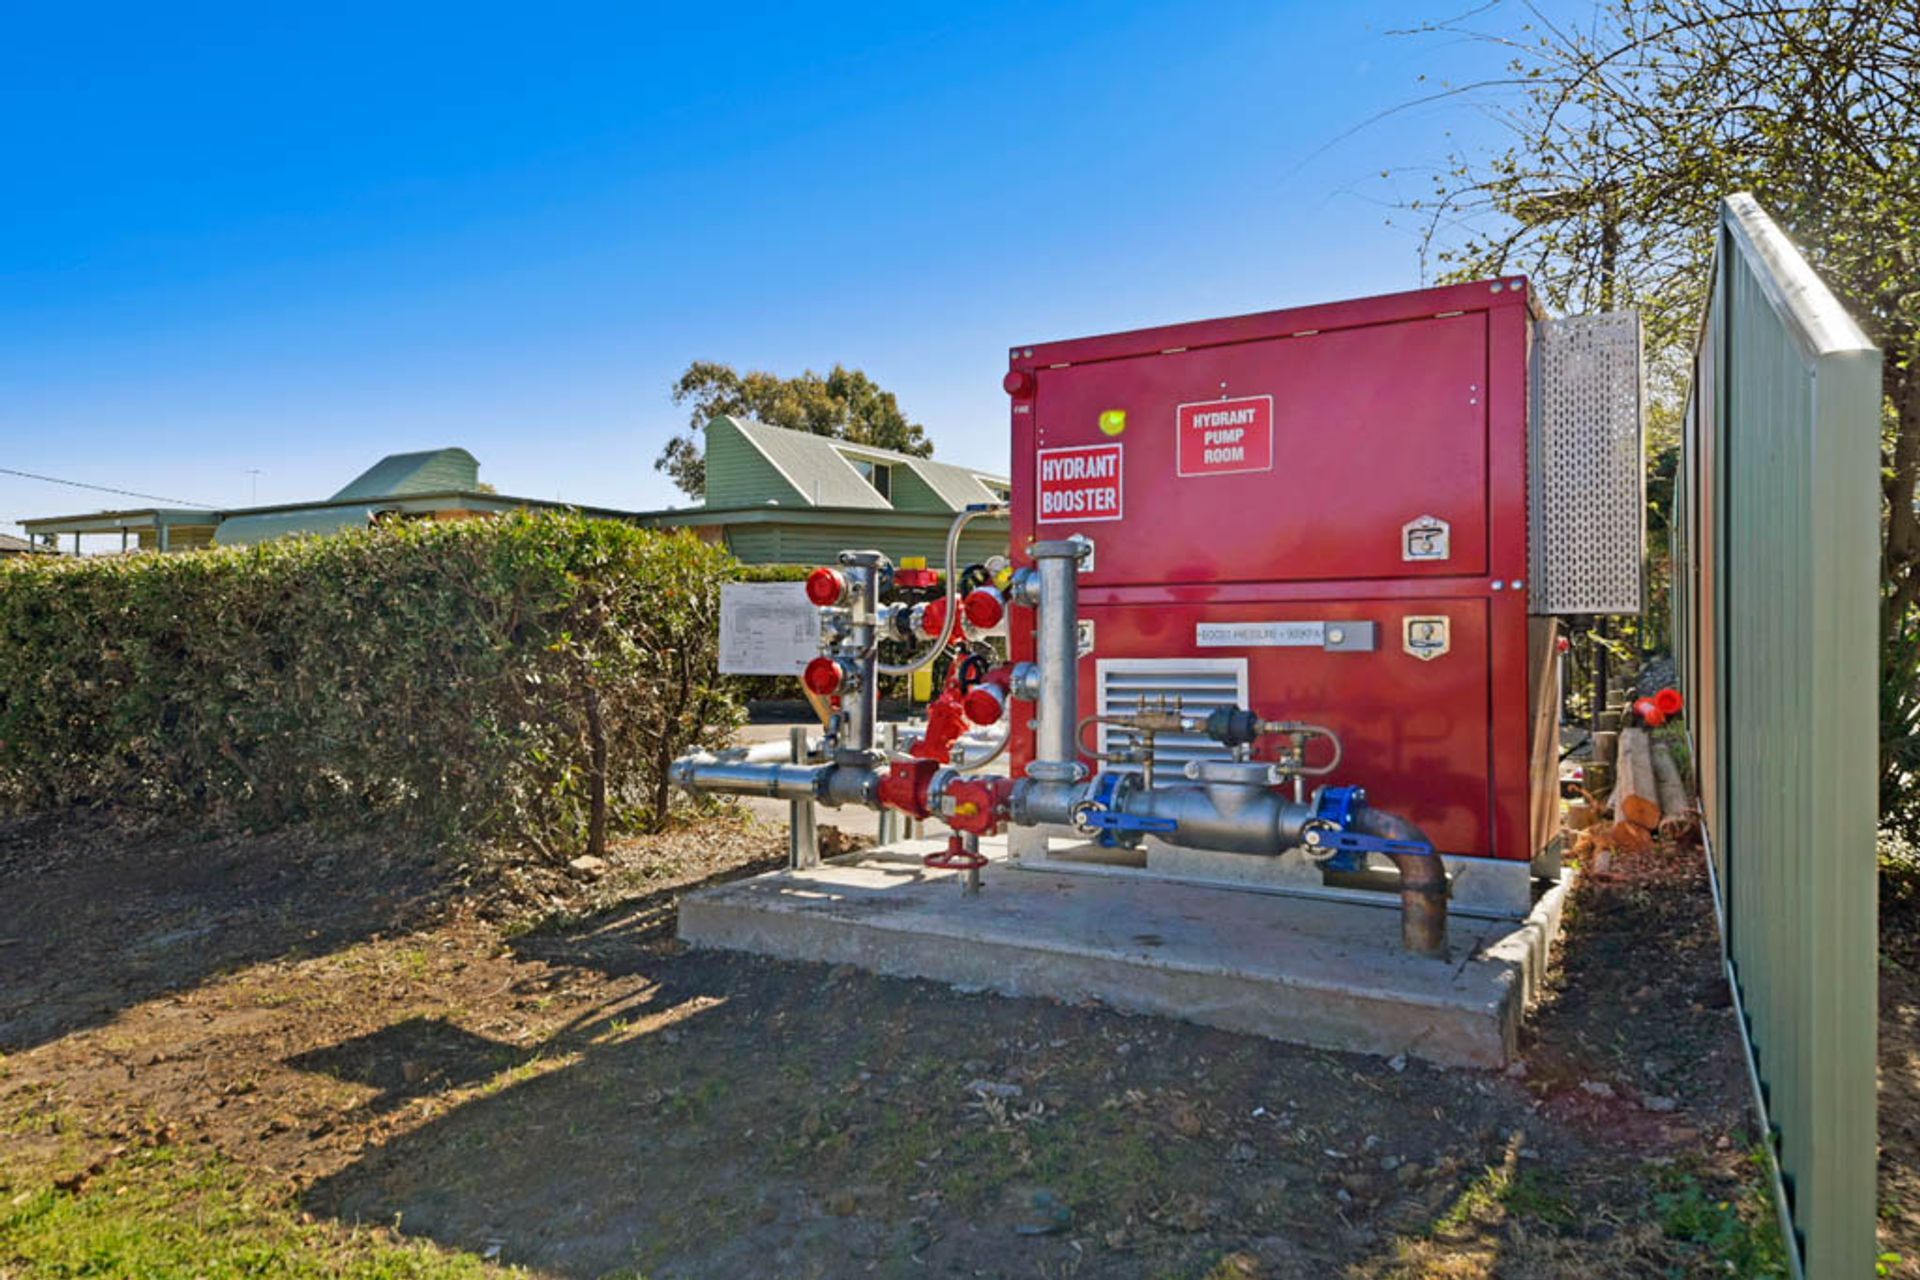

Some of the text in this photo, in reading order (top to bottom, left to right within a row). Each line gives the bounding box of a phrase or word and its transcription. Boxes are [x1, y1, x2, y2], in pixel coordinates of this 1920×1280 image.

[1193, 408, 1256, 428] HYDRANT
[1204, 428, 1245, 445] PUMP
[1204, 446, 1245, 464] ROOM
[1042, 454, 1117, 481] HYDRANT
[1042, 487, 1117, 513] BOOSTER
